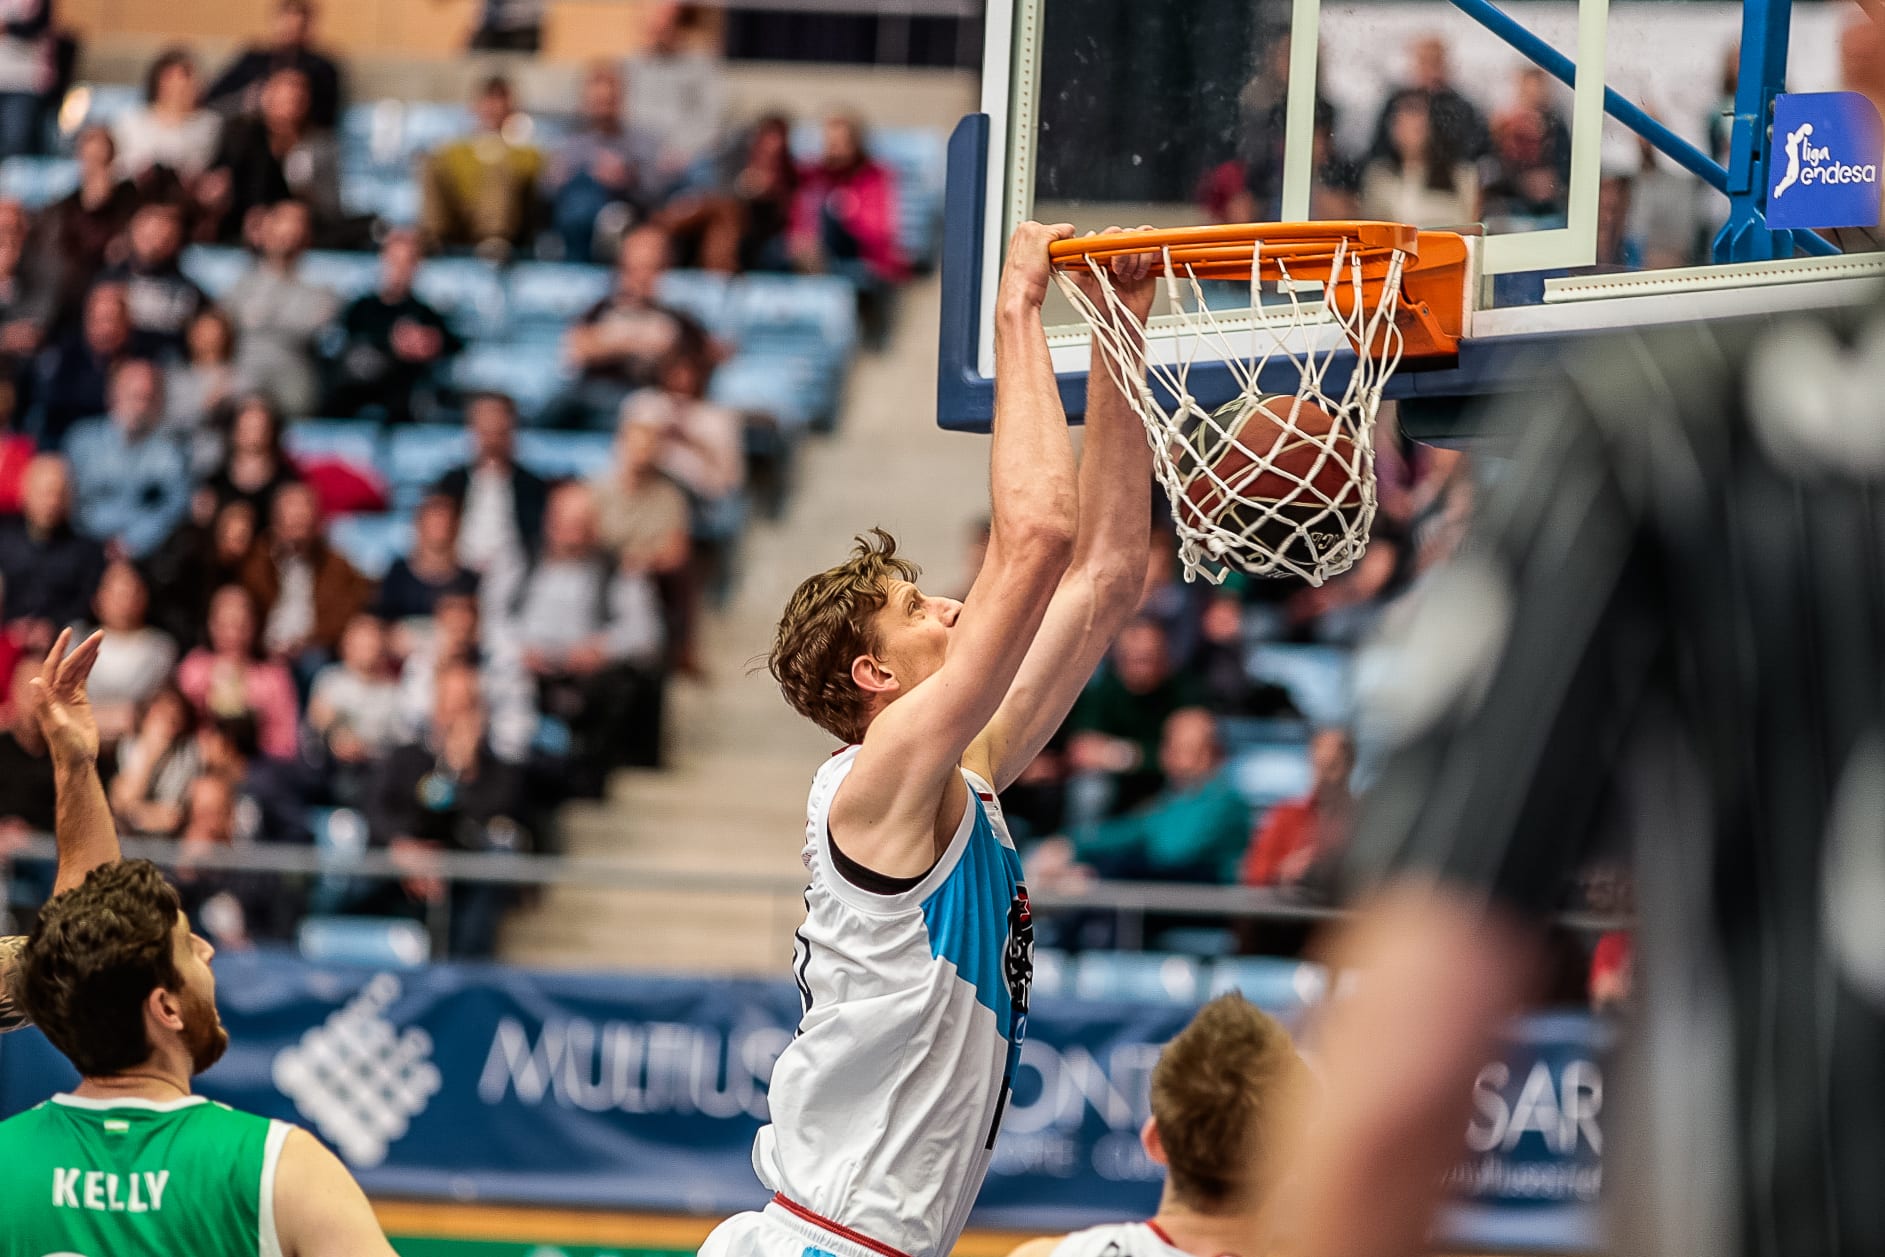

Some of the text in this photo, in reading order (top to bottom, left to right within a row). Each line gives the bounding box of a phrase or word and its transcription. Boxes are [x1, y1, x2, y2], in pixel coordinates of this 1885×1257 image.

[1802, 137, 1830, 166] liga
[1800, 161, 1876, 185] endesa
[477, 1016, 789, 1121] MULTIUS
[1001, 1038, 1160, 1136] ONT
[52, 1167, 170, 1213] KELLY
